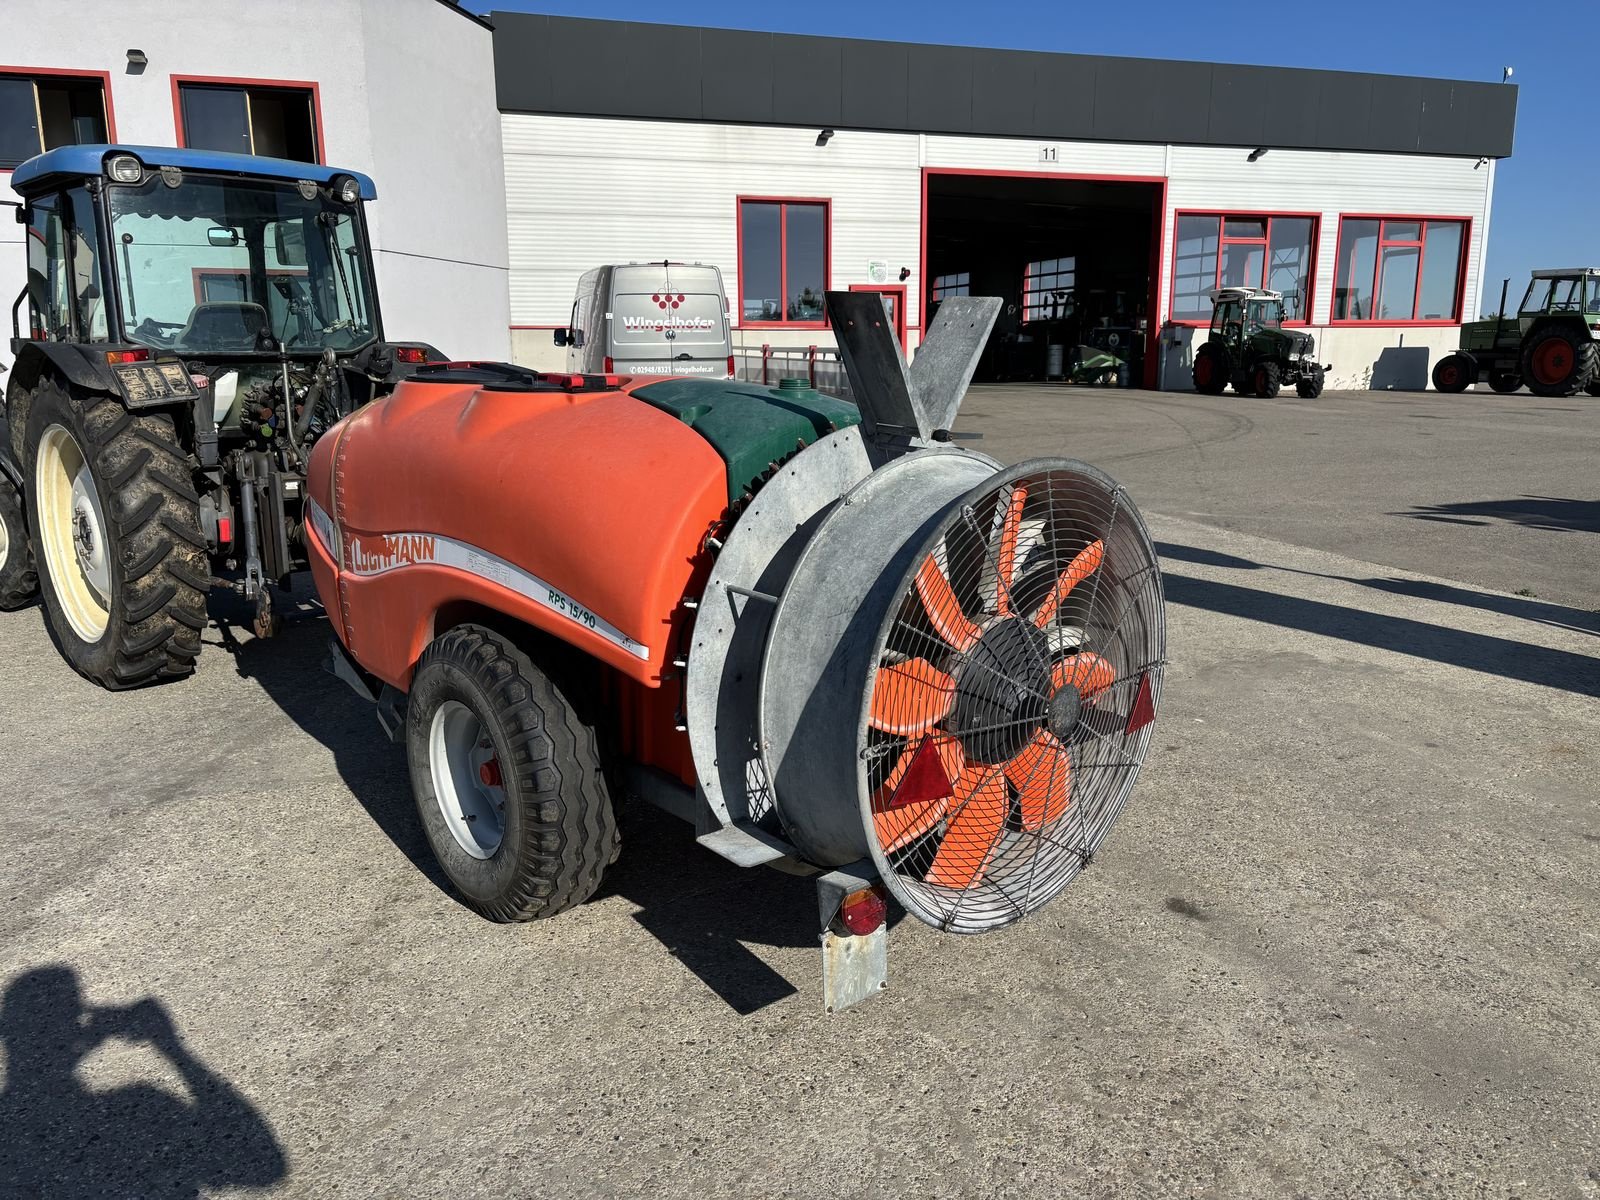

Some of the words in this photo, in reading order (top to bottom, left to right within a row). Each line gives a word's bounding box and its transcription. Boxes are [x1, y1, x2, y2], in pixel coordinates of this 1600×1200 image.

[1042, 147, 1056, 160] 11
[622, 316, 715, 332] Wingelhofer
[548, 589, 566, 610] RPS
[569, 602, 596, 629] 15/90
